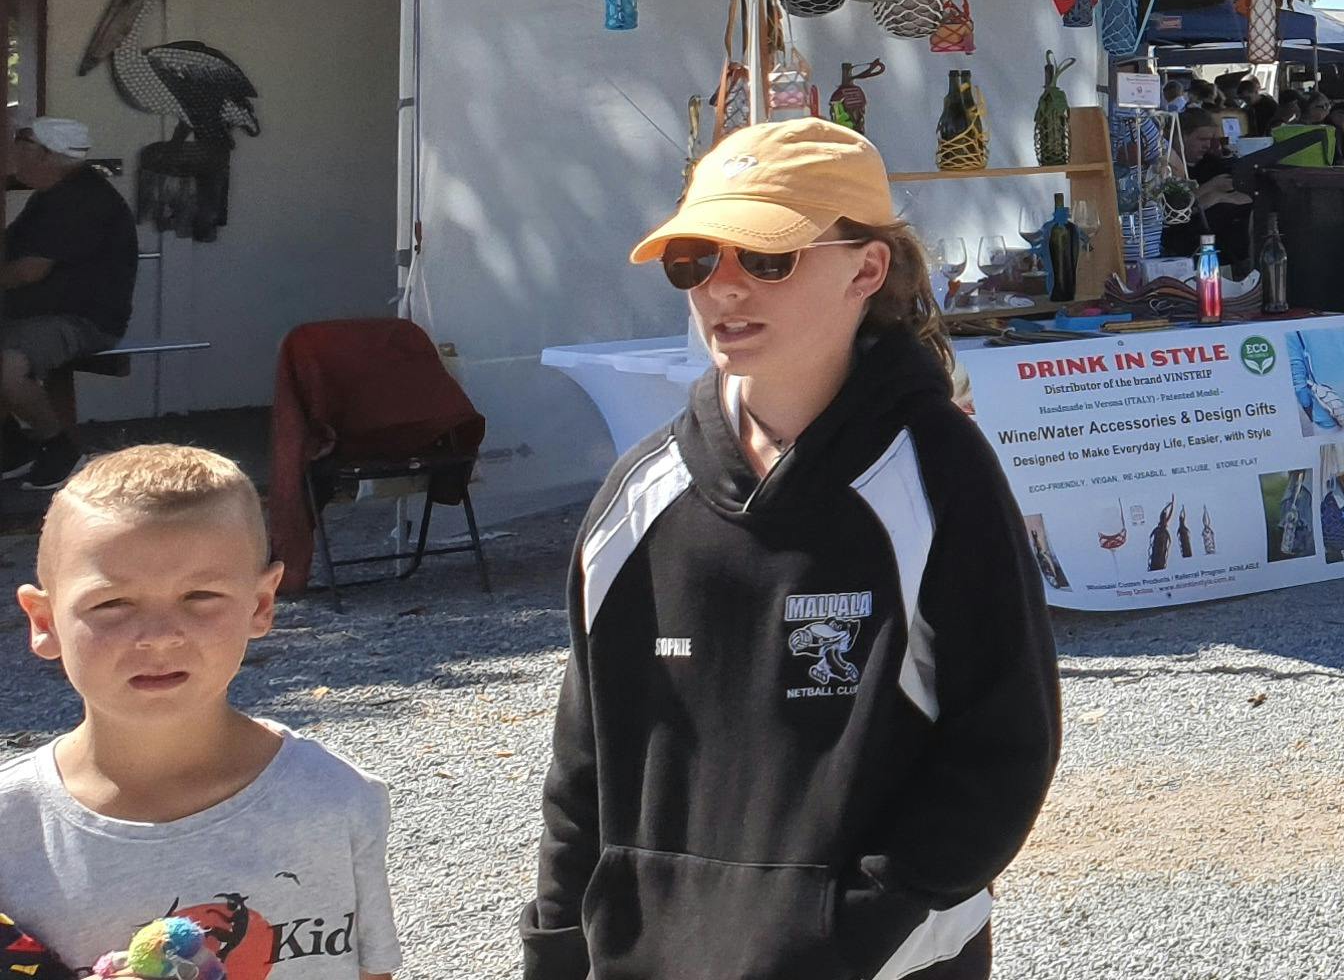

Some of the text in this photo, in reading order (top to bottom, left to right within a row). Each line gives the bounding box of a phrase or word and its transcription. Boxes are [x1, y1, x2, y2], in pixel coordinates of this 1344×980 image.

[1017, 344, 1230, 380] DRINK IN STYLE
[1246, 343, 1268, 354] ECO
[1044, 369, 1213, 395] Distributor of the brand VINSTRIP
[1039, 402, 1084, 415] Handmade
[1085, 401, 1094, 411] in
[1094, 398, 1123, 409] Verona
[1124, 394, 1156, 408] (ITALY)
[1160, 391, 1196, 404] Patented
[1196, 387, 1220, 398] Model
[998, 401, 1277, 445] Wine/Water Accessories & Design Gifts
[1013, 427, 1272, 467] Designed to Make Everyday Life, Easier, with Style
[786, 591, 872, 620] MALLALA
[655, 637, 692, 657] SOPHIE
[786, 684, 834, 699] NETBALL
[268, 912, 355, 964] Kid
